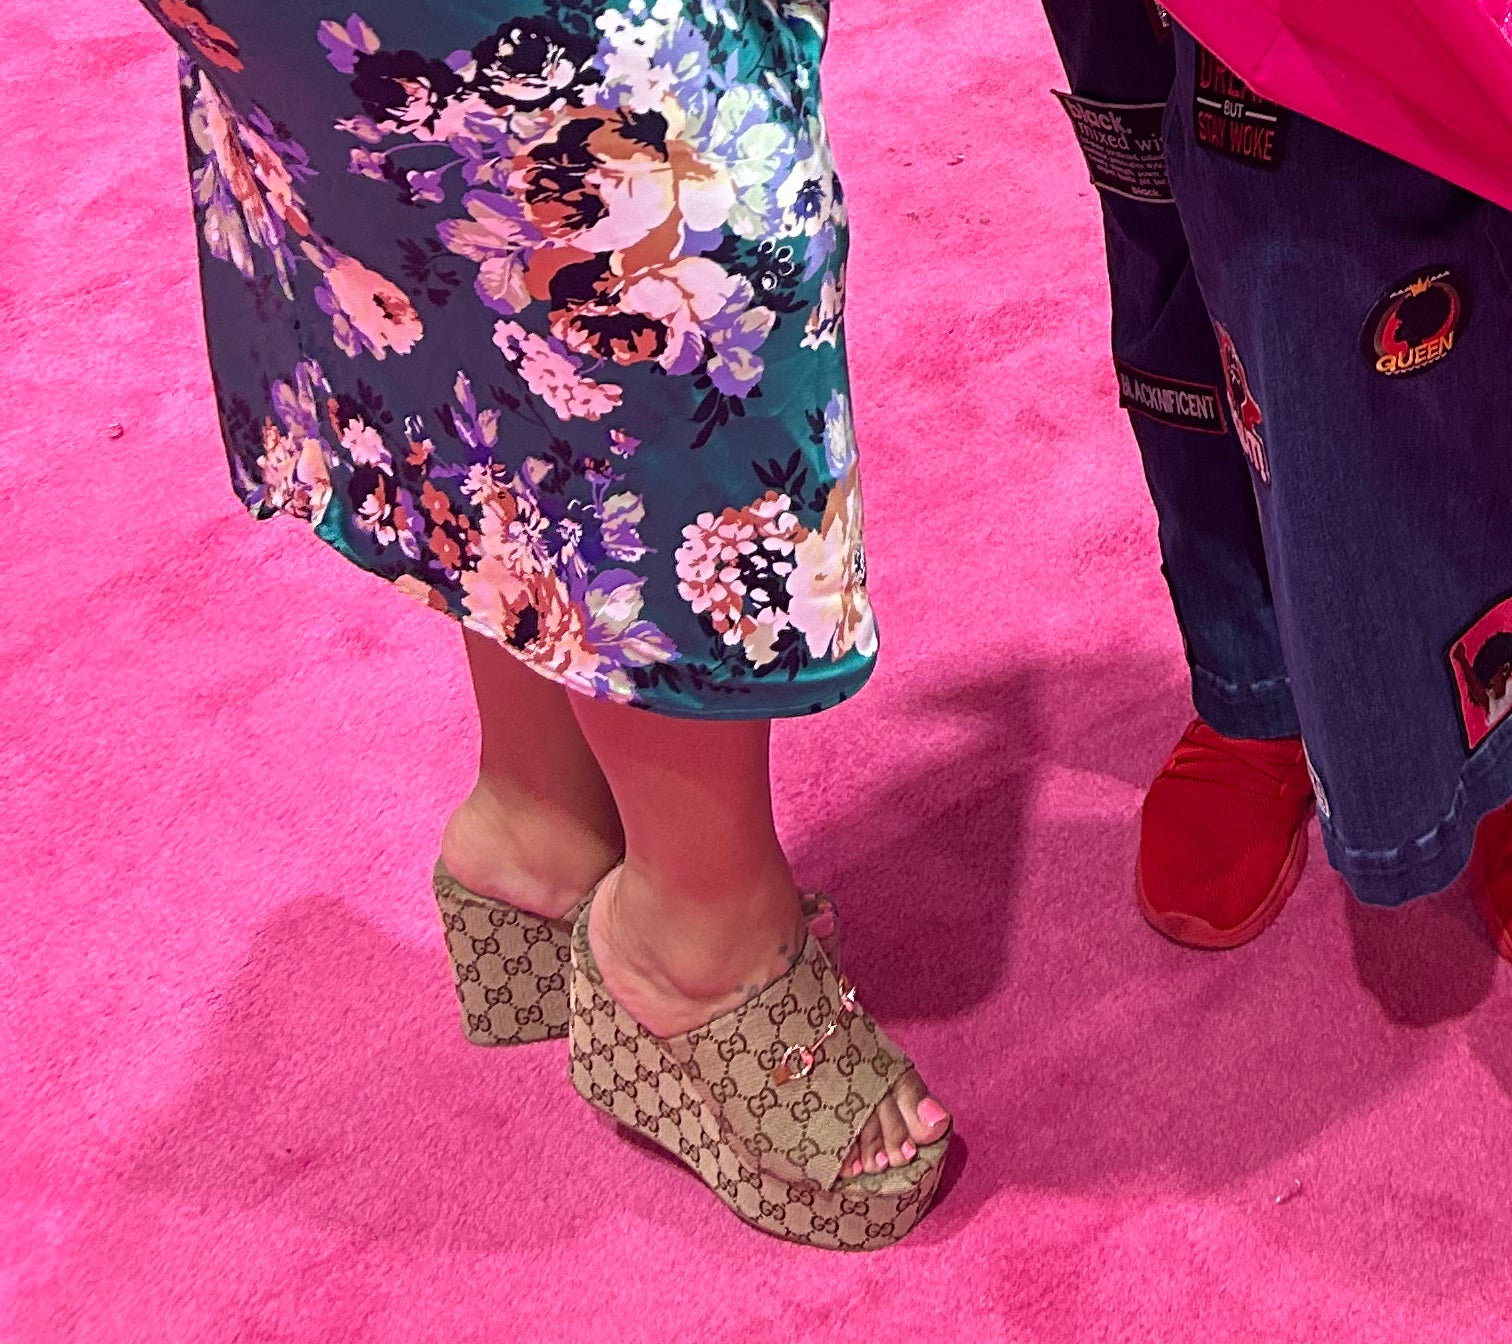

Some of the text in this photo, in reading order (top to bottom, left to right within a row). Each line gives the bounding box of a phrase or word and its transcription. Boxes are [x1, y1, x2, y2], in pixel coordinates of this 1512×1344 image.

[1223, 99, 1245, 119] BUT
[1077, 122, 1164, 152] mixed wi
[1230, 120, 1275, 161] WOKE
[1375, 329, 1455, 373] QUEEN
[1120, 372, 1216, 420] BLACKNIFICENT
